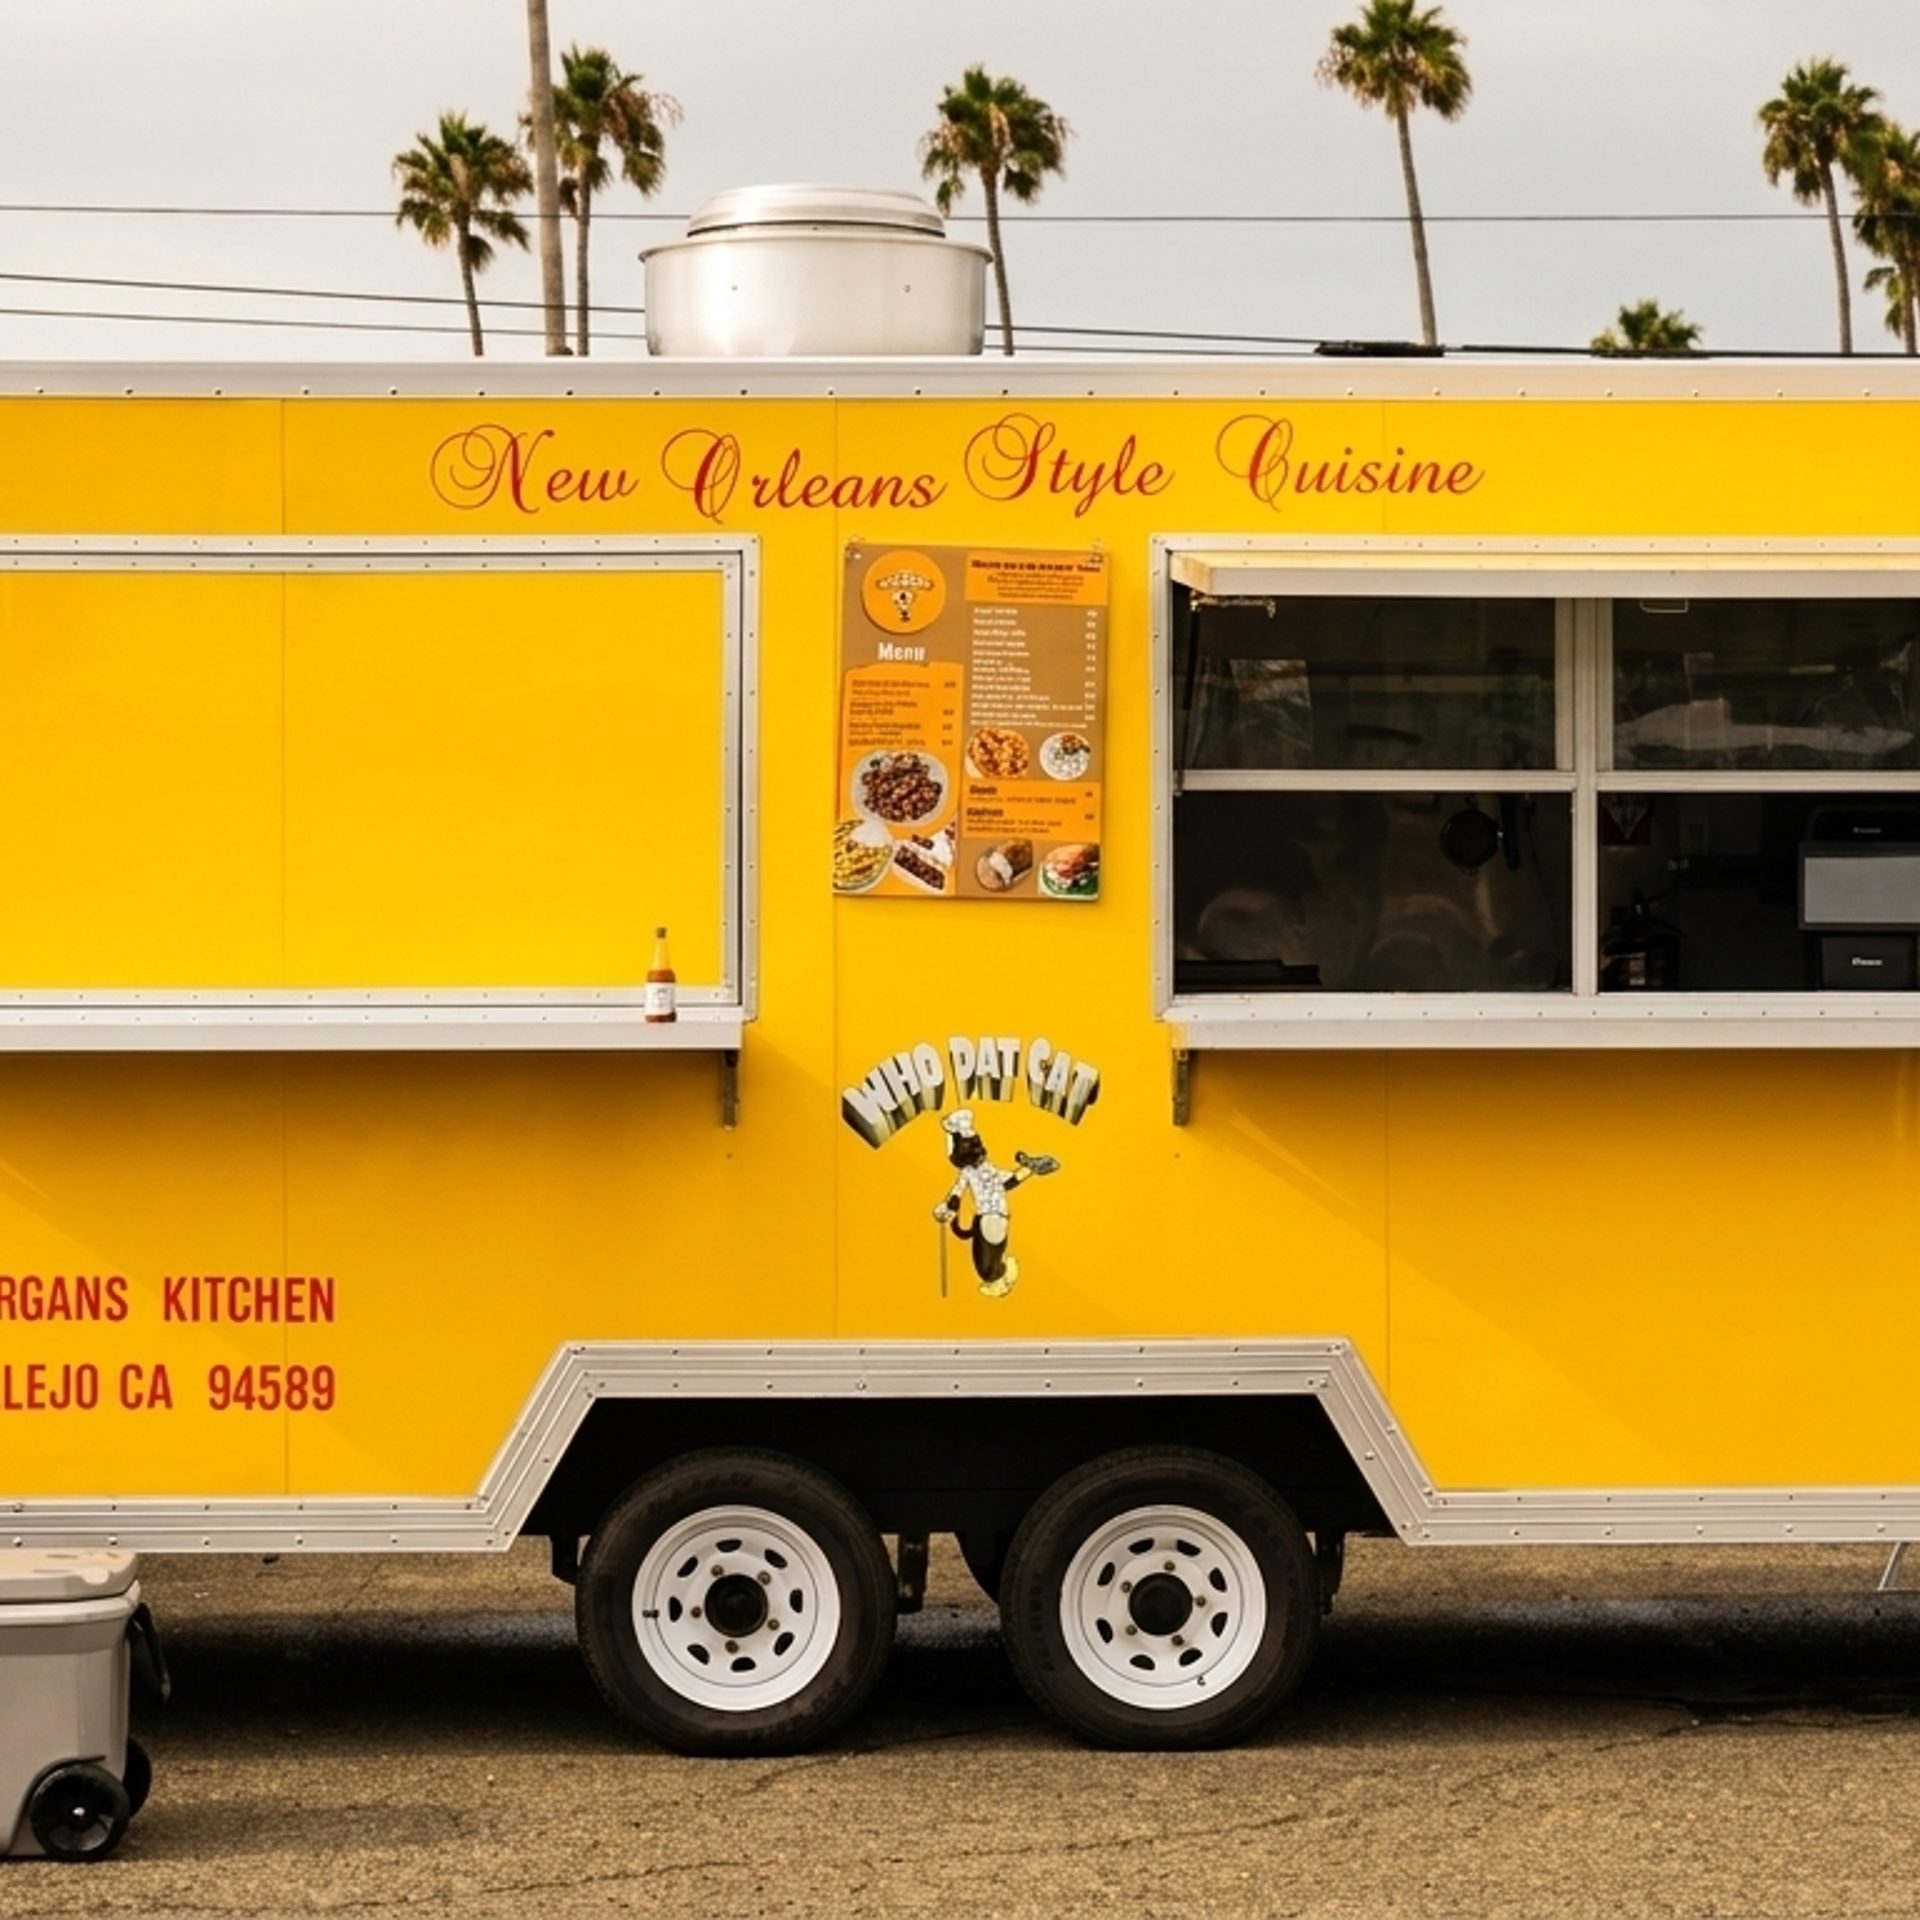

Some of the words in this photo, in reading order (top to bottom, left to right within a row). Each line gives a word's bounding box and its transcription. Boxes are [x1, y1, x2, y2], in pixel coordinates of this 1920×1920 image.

[430, 424, 639, 514] New
[661, 428, 947, 524] Orleans
[964, 412, 1175, 518] Style
[1215, 414, 1485, 513] Cuisine
[878, 641, 926, 660] Menu
[842, 1042, 945, 1149] WHO
[948, 1036, 1020, 1104] DAT
[1026, 1037, 1101, 1126] CAT
[0, 1275, 128, 1322] RGANS
[163, 1276, 335, 1323] KITCHEN
[0, 1363, 99, 1410] LEJO
[119, 1363, 173, 1410] CA
[208, 1364, 336, 1411] 94589
